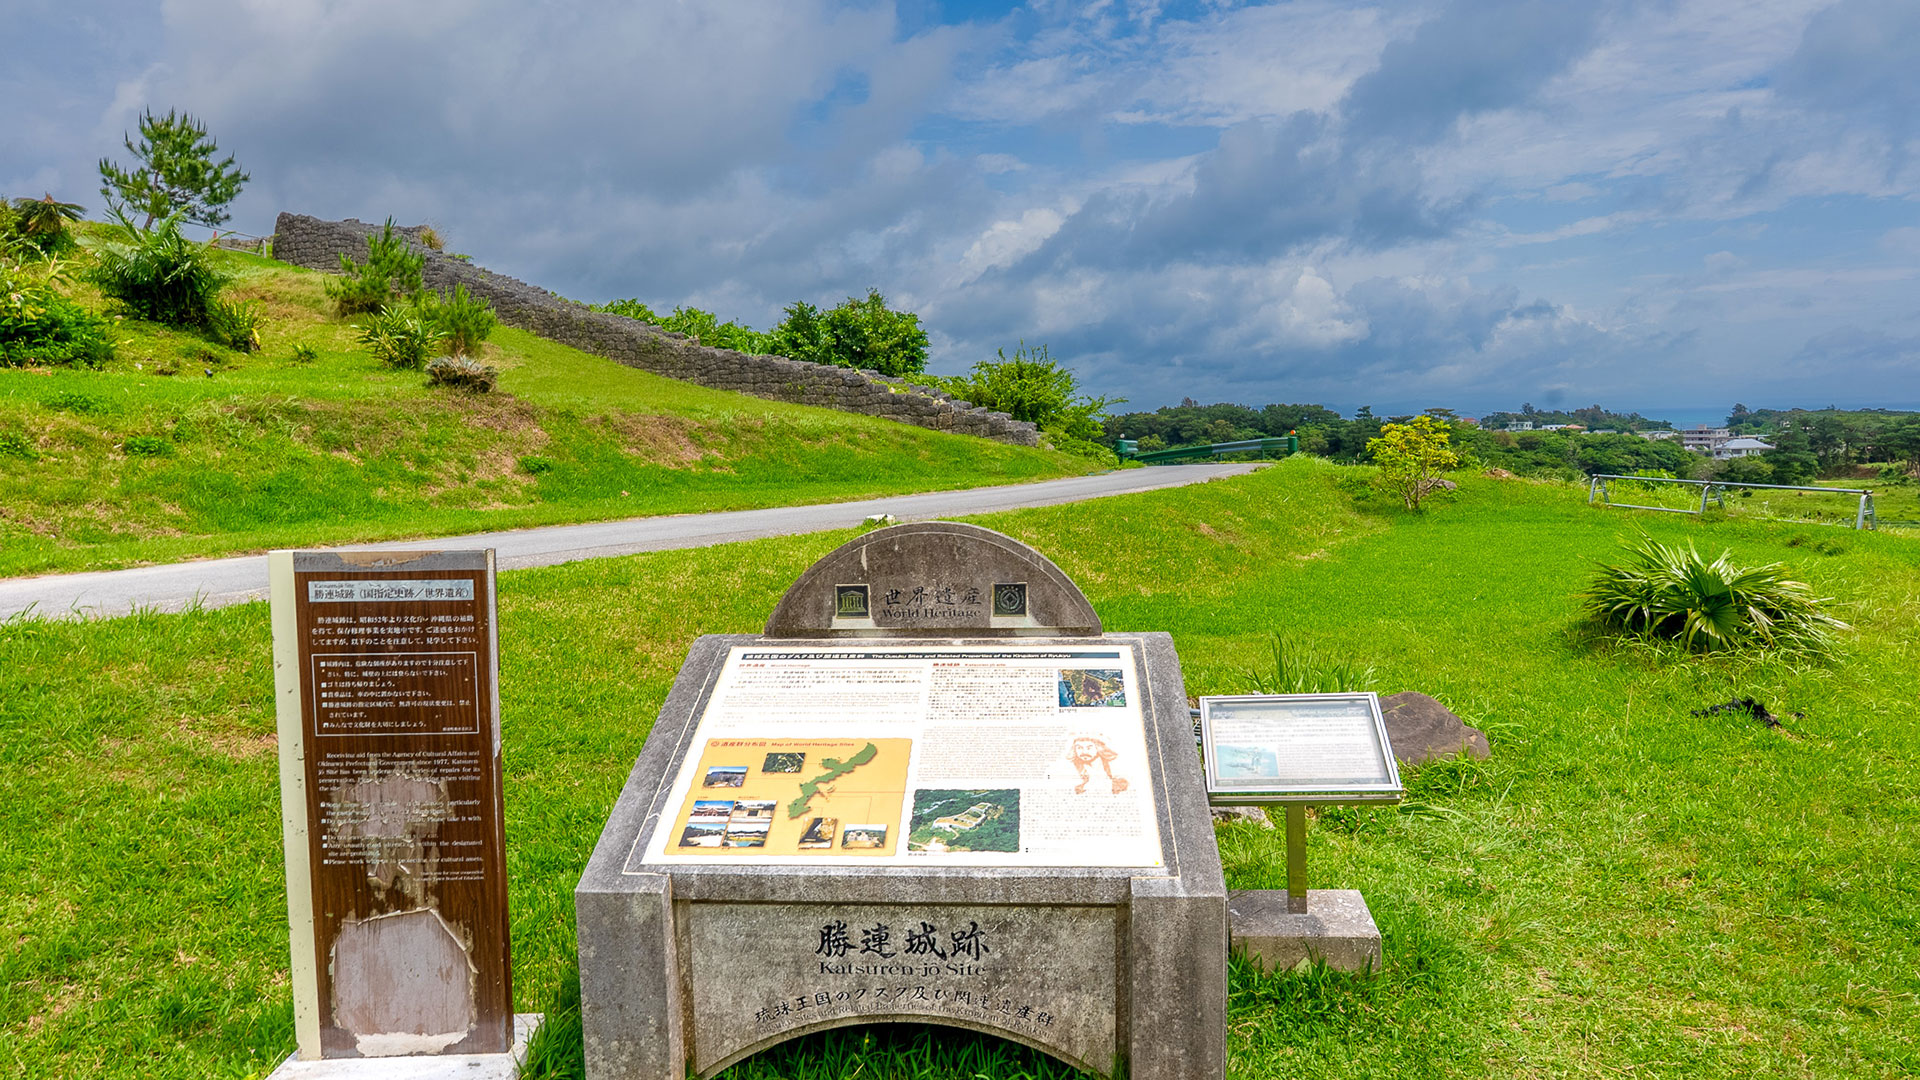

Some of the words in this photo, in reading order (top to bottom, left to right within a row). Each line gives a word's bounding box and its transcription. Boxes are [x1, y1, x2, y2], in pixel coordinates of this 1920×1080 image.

[880, 586, 982, 606] 世界遺産
[883, 609, 919, 618] World
[924, 608, 981, 618] Heritage
[815, 920, 990, 961] 勝連城跡
[945, 961, 987, 977] Site
